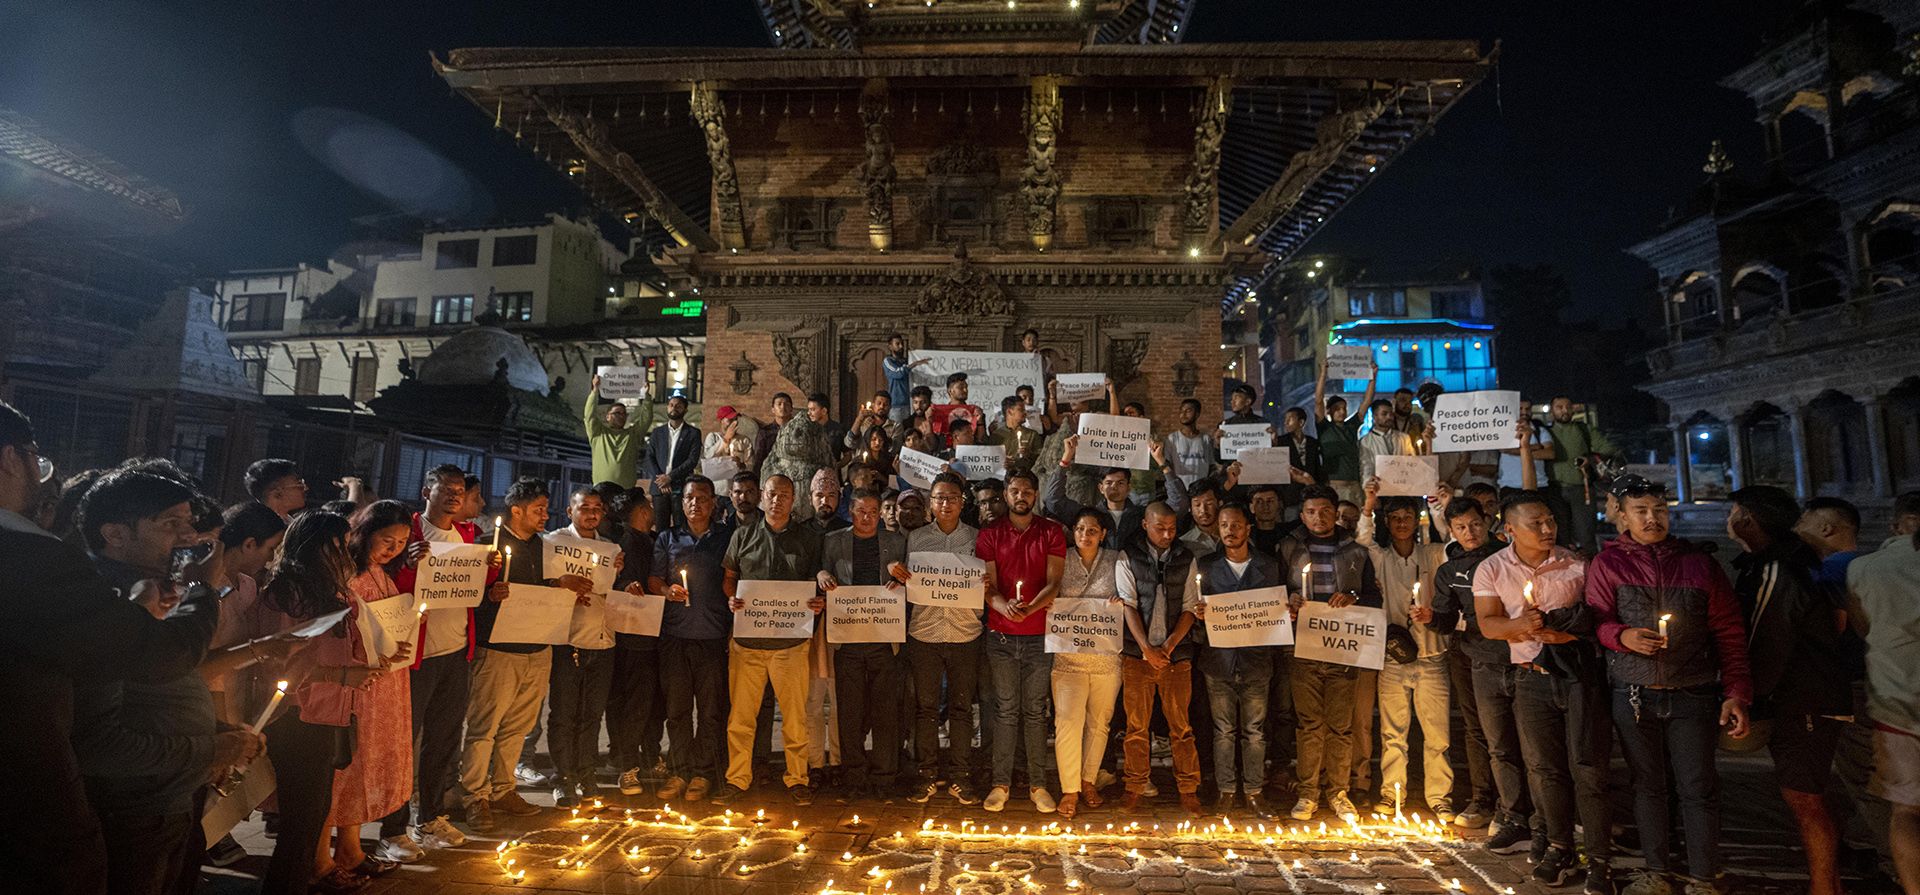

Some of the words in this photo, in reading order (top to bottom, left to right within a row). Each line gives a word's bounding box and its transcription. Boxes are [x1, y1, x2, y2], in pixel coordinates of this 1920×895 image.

[951, 357, 993, 370] NEPALI
[995, 358, 1039, 371] STUDENTS
[993, 376, 1019, 387] LIVES
[1437, 409, 1470, 419] Peace
[1473, 407, 1489, 416] for
[1492, 405, 1512, 415] All,
[1440, 420, 1489, 431] Freedom
[1493, 418, 1509, 427] for
[1082, 427, 1107, 437] Unite
[1110, 429, 1119, 438] in
[1122, 431, 1146, 441] Light
[1450, 433, 1500, 444] Captives
[1090, 439, 1104, 448] for
[1106, 441, 1137, 451] Nepali
[962, 455, 980, 463] END
[982, 455, 1000, 463] THE
[1100, 451, 1126, 461] Lives
[917, 459, 942, 471] Passag
[970, 464, 992, 473] WAR
[554, 545, 582, 559] END
[428, 555, 448, 567] Our
[449, 556, 482, 567] Hearts
[433, 571, 471, 583] Beckon
[912, 564, 939, 574] Unite
[942, 566, 951, 575] in
[954, 567, 981, 578] Light
[921, 577, 935, 586] for
[938, 578, 971, 590] Nepali
[421, 588, 448, 599] Them
[450, 587, 479, 598] Home
[931, 590, 959, 600] Lives
[752, 598, 788, 607] Candles
[835, 597, 867, 605] Hopeful
[1212, 602, 1246, 613] Hopeful
[1248, 600, 1280, 609] Flames
[744, 609, 770, 618] Hope,
[772, 609, 806, 619] Prayers
[860, 607, 886, 615] Nepali
[1241, 610, 1269, 620] Nepali
[754, 620, 767, 628] for
[769, 620, 795, 628] Peace
[832, 617, 871, 625] Students'
[1053, 613, 1088, 622] Return
[1090, 613, 1116, 624] Back
[1050, 624, 1070, 633] Our
[1072, 625, 1118, 636] Students
[1213, 621, 1254, 631] Students'
[1255, 619, 1286, 628] Return
[1308, 617, 1340, 632] END
[1345, 622, 1375, 637] THE
[1073, 638, 1096, 647] Safe
[1322, 635, 1358, 651] WAR
